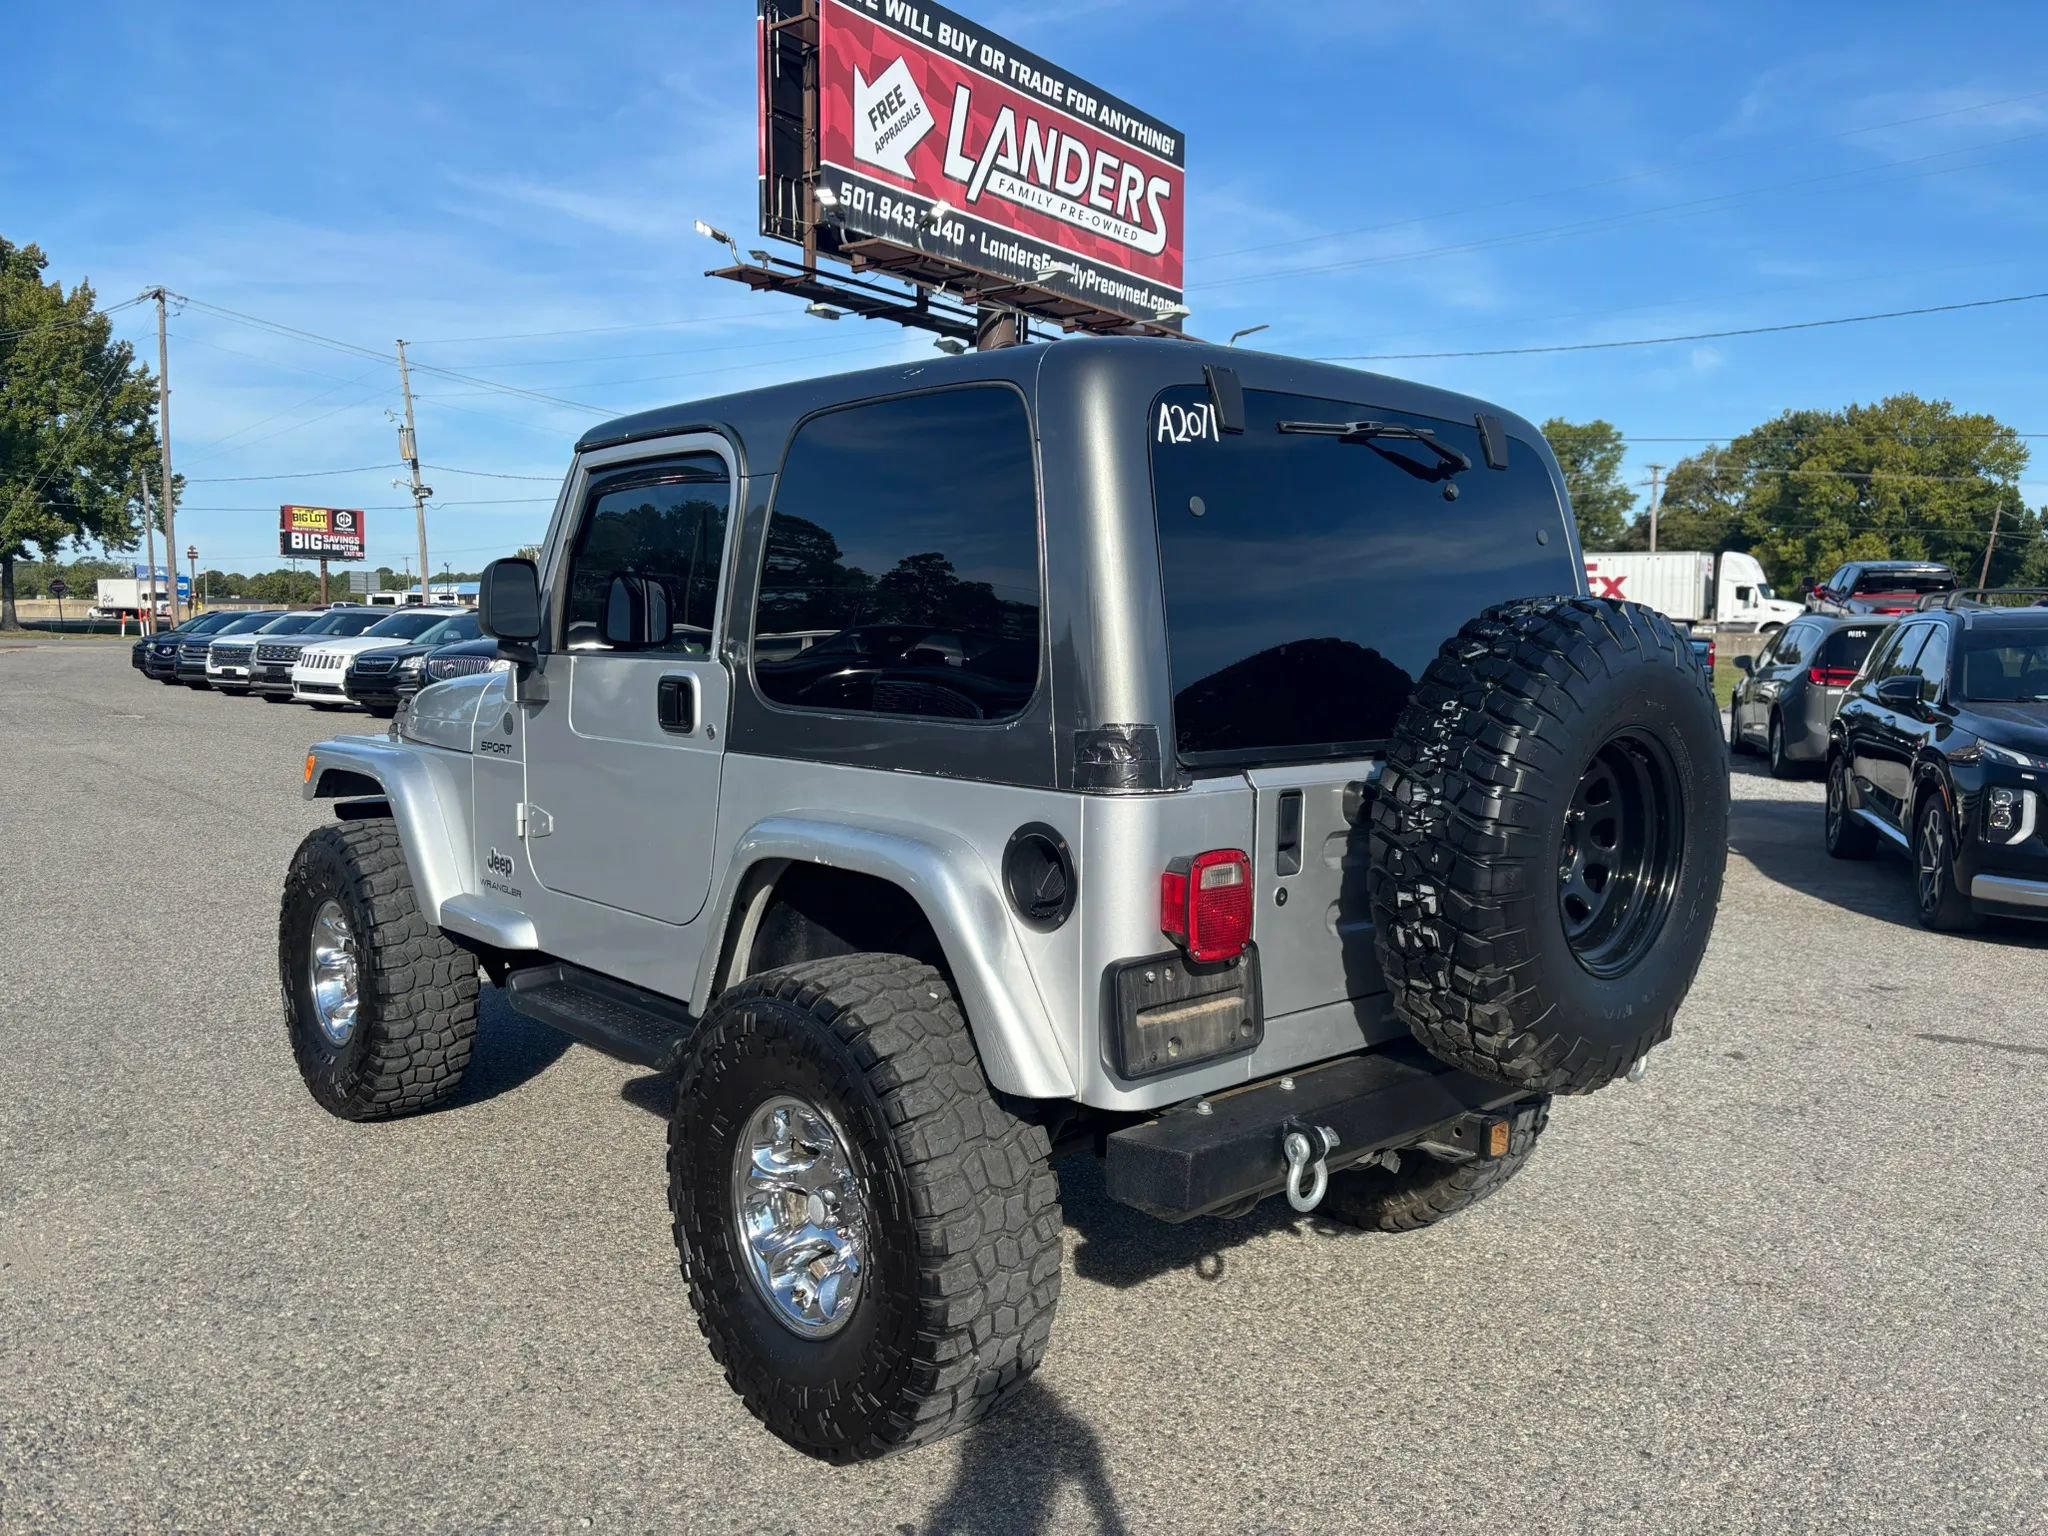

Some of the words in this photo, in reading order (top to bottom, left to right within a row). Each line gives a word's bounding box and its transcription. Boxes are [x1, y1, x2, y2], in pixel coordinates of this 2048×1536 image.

[884, 0, 933, 39] WILL
[937, 21, 977, 58] BUY
[979, 43, 1006, 74] OR
[1009, 57, 1064, 103] TRADE
[1066, 87, 1098, 119] FOR
[1099, 104, 1176, 157] ANYTHING!
[867, 83, 906, 132] FREE
[874, 102, 921, 155] APPRAISALS
[944, 84, 1171, 254] LANDERS
[840, 181, 965, 246] 501.943.040
[998, 178, 1053, 208] FAMILY
[1060, 202, 1138, 240] PRE-OWNED
[1157, 402, 1220, 443] A2071
[292, 513, 308, 522] BIG
[309, 513, 327, 523] LOT
[291, 532, 322, 550] BIG
[323, 535, 360, 545] SAVINGS
[480, 741, 512, 755] SPORT
[487, 847, 514, 879] Jeep
[480, 878, 522, 898] WRANGLER
